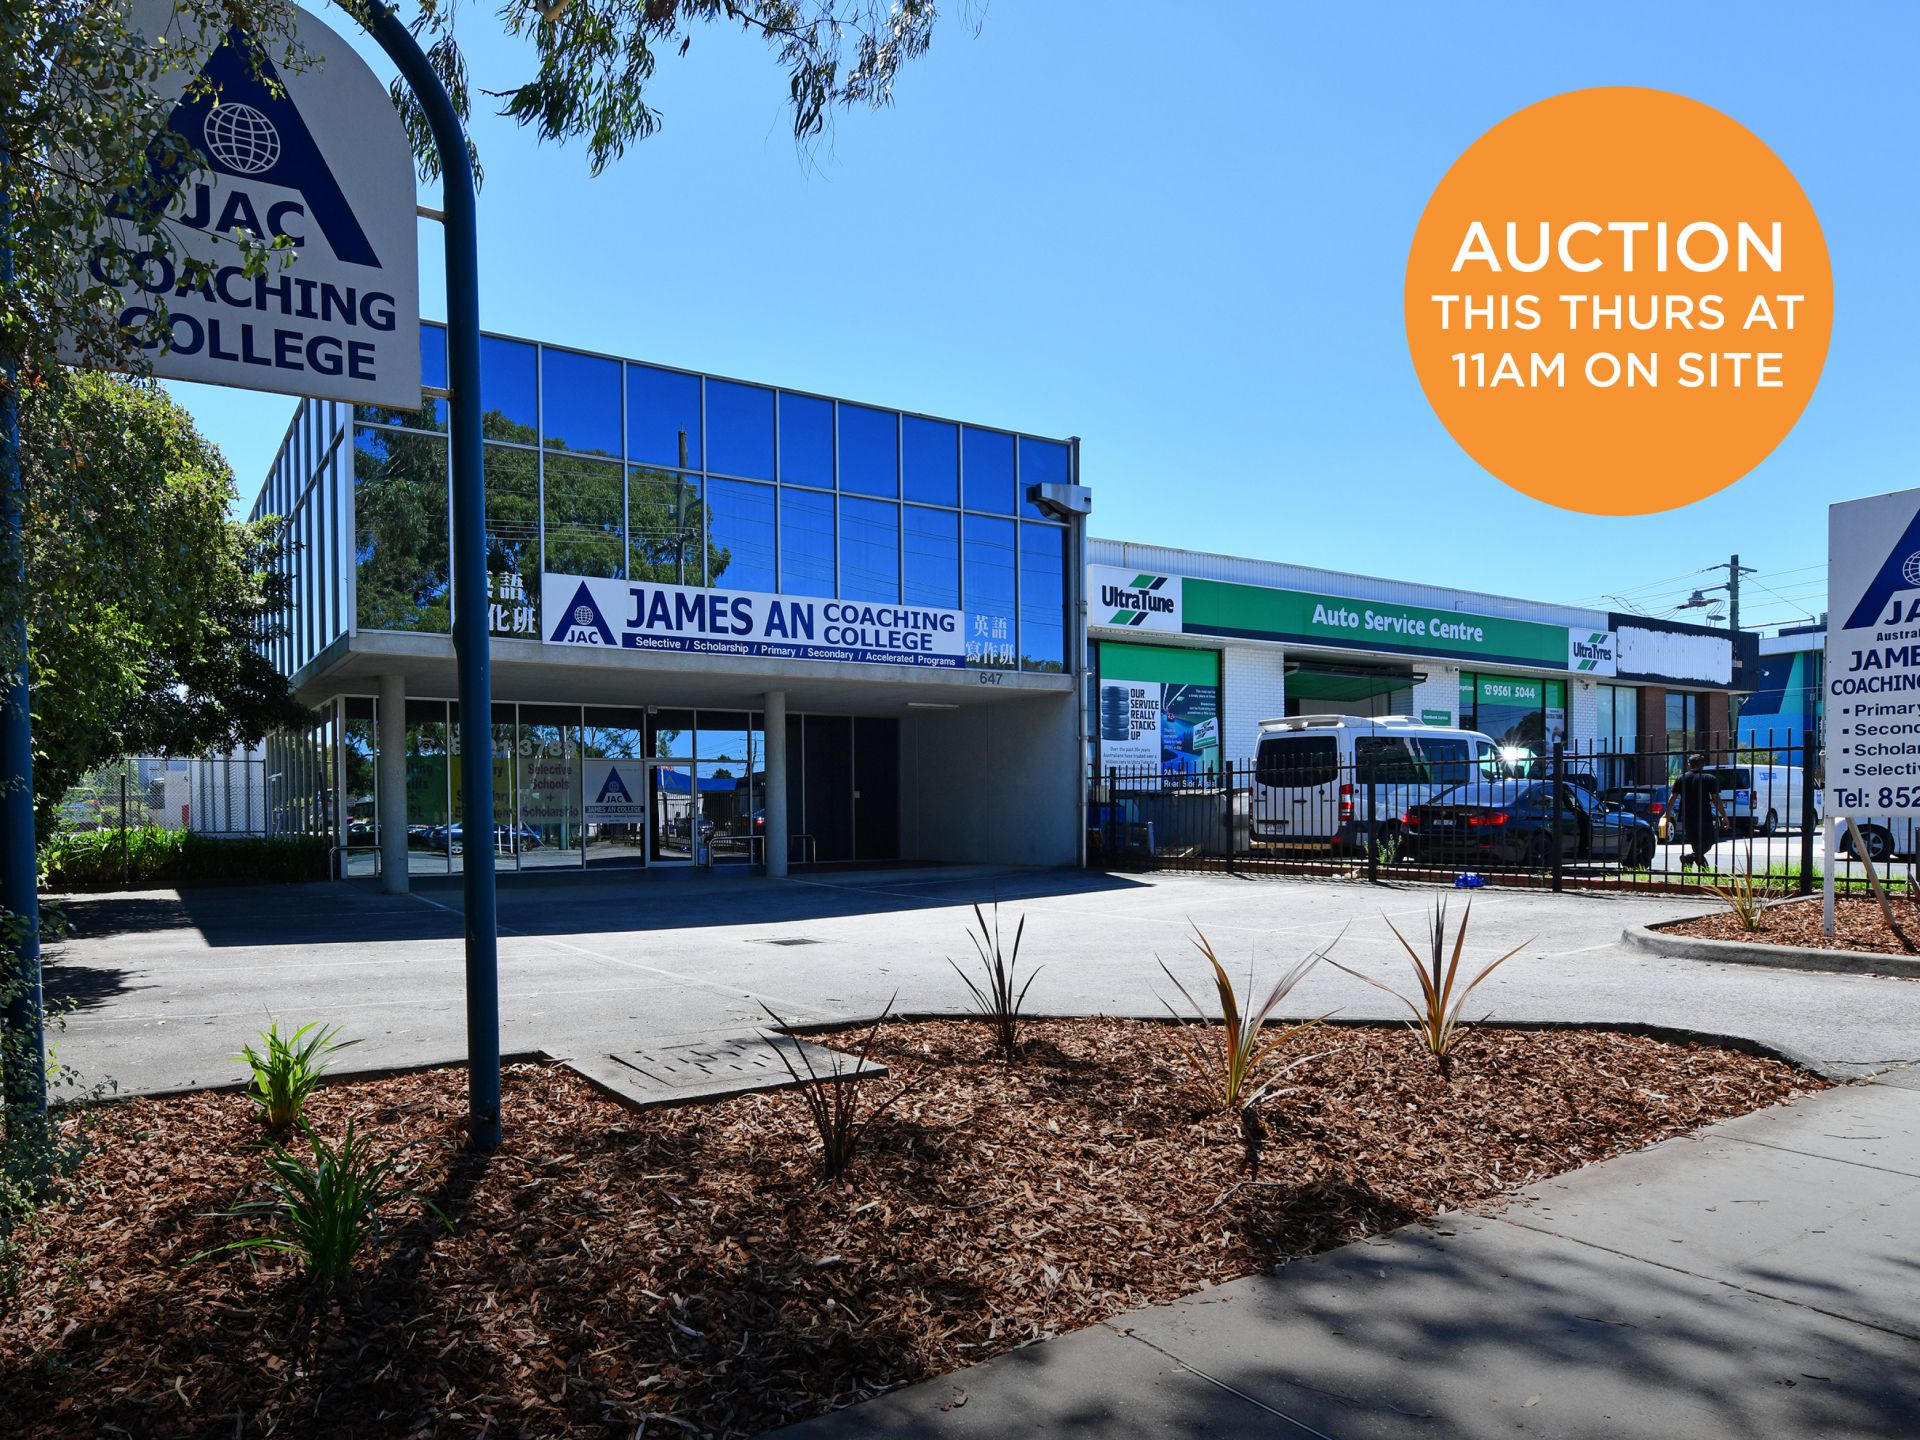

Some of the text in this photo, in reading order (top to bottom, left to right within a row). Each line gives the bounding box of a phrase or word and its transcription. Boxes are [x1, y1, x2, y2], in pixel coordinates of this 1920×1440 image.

[179, 183, 305, 248] JAC
[89, 243, 397, 332] COACHING
[118, 306, 377, 382] COLLEGE
[1101, 584, 1175, 614] UltraTune
[487, 603, 537, 634] 化班
[626, 587, 815, 641] JAMES AN
[823, 603, 955, 633] COACHING
[1312, 604, 1484, 642] Auto Service Centre
[567, 629, 598, 645] JAC
[973, 614, 1008, 640] 英語
[823, 625, 933, 652] COLLEGE
[635, 637, 681, 649] Selective
[693, 641, 749, 654] Scholarship
[761, 646, 796, 658] Primary
[807, 648, 854, 661] Secondary
[866, 652, 914, 663] Accelerated
[918, 656, 956, 668] Programs
[979, 672, 1003, 685] 647
[1831, 673, 1920, 696] COACHIN
[1130, 688, 1145, 698] OUR
[1492, 685, 1536, 698] 9561 5044
[1130, 700, 1160, 710] SERVICE
[1130, 710, 1156, 720] REALLY
[1130, 721, 1156, 731] STACKS
[527, 763, 573, 775] Selective
[532, 779, 570, 790] Schools
[605, 795, 623, 804] JAC
[1833, 788, 1870, 808] Tel:
[522, 805, 579, 818] Scholarship
